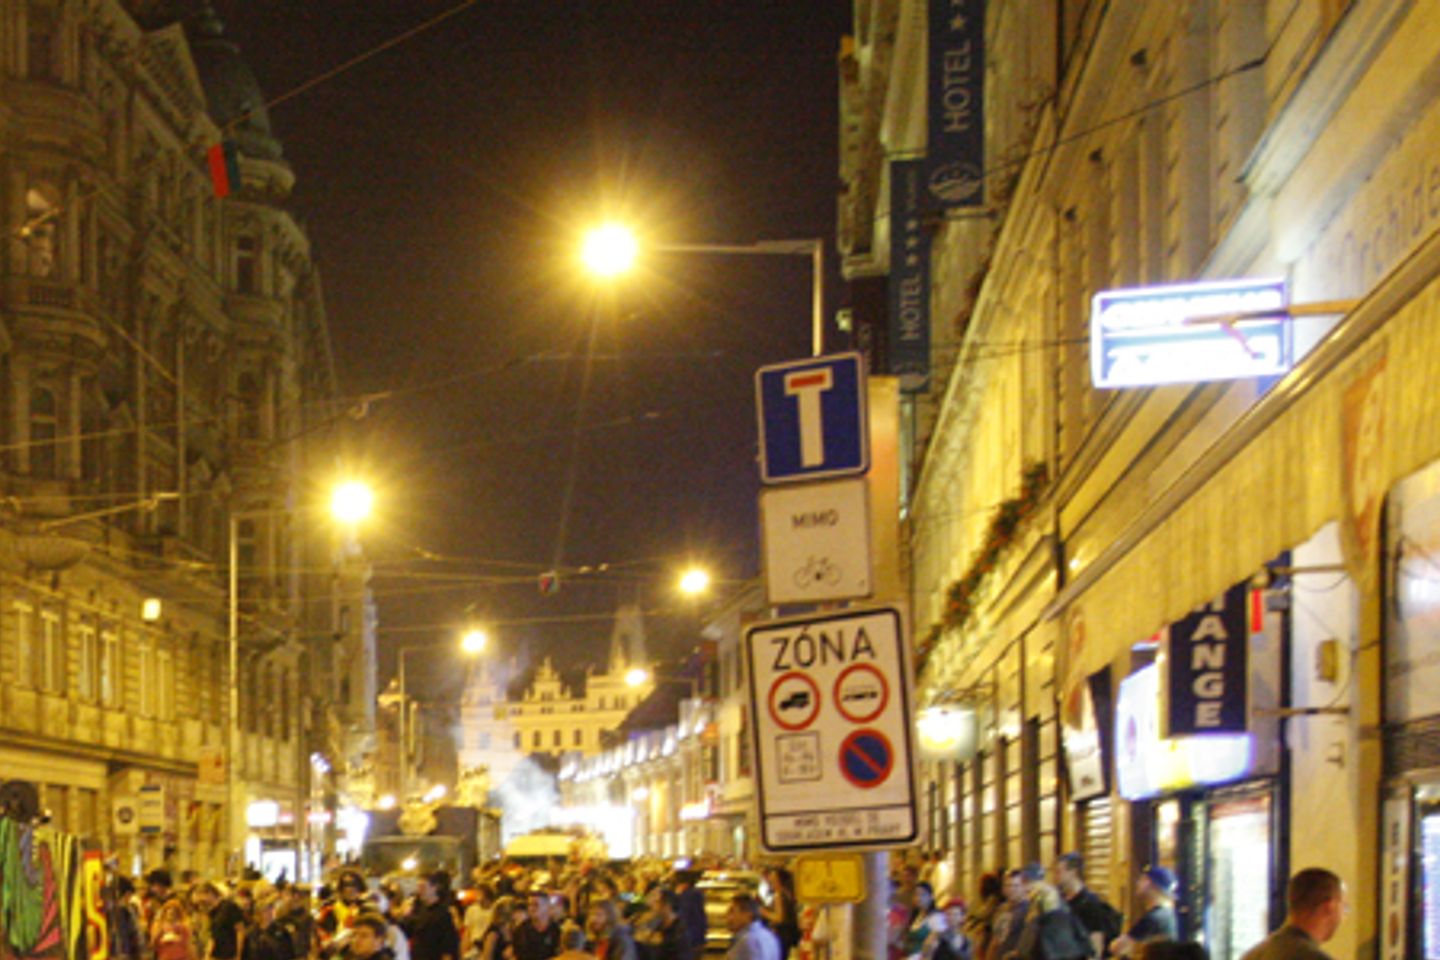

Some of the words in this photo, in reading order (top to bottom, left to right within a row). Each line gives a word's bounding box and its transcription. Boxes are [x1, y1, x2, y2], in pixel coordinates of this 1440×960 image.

[943, 38, 972, 133] HOTEL
[900, 275, 922, 341] HOTEL
[792, 509, 839, 528] MIMO
[771, 625, 877, 671] ZÓNA
